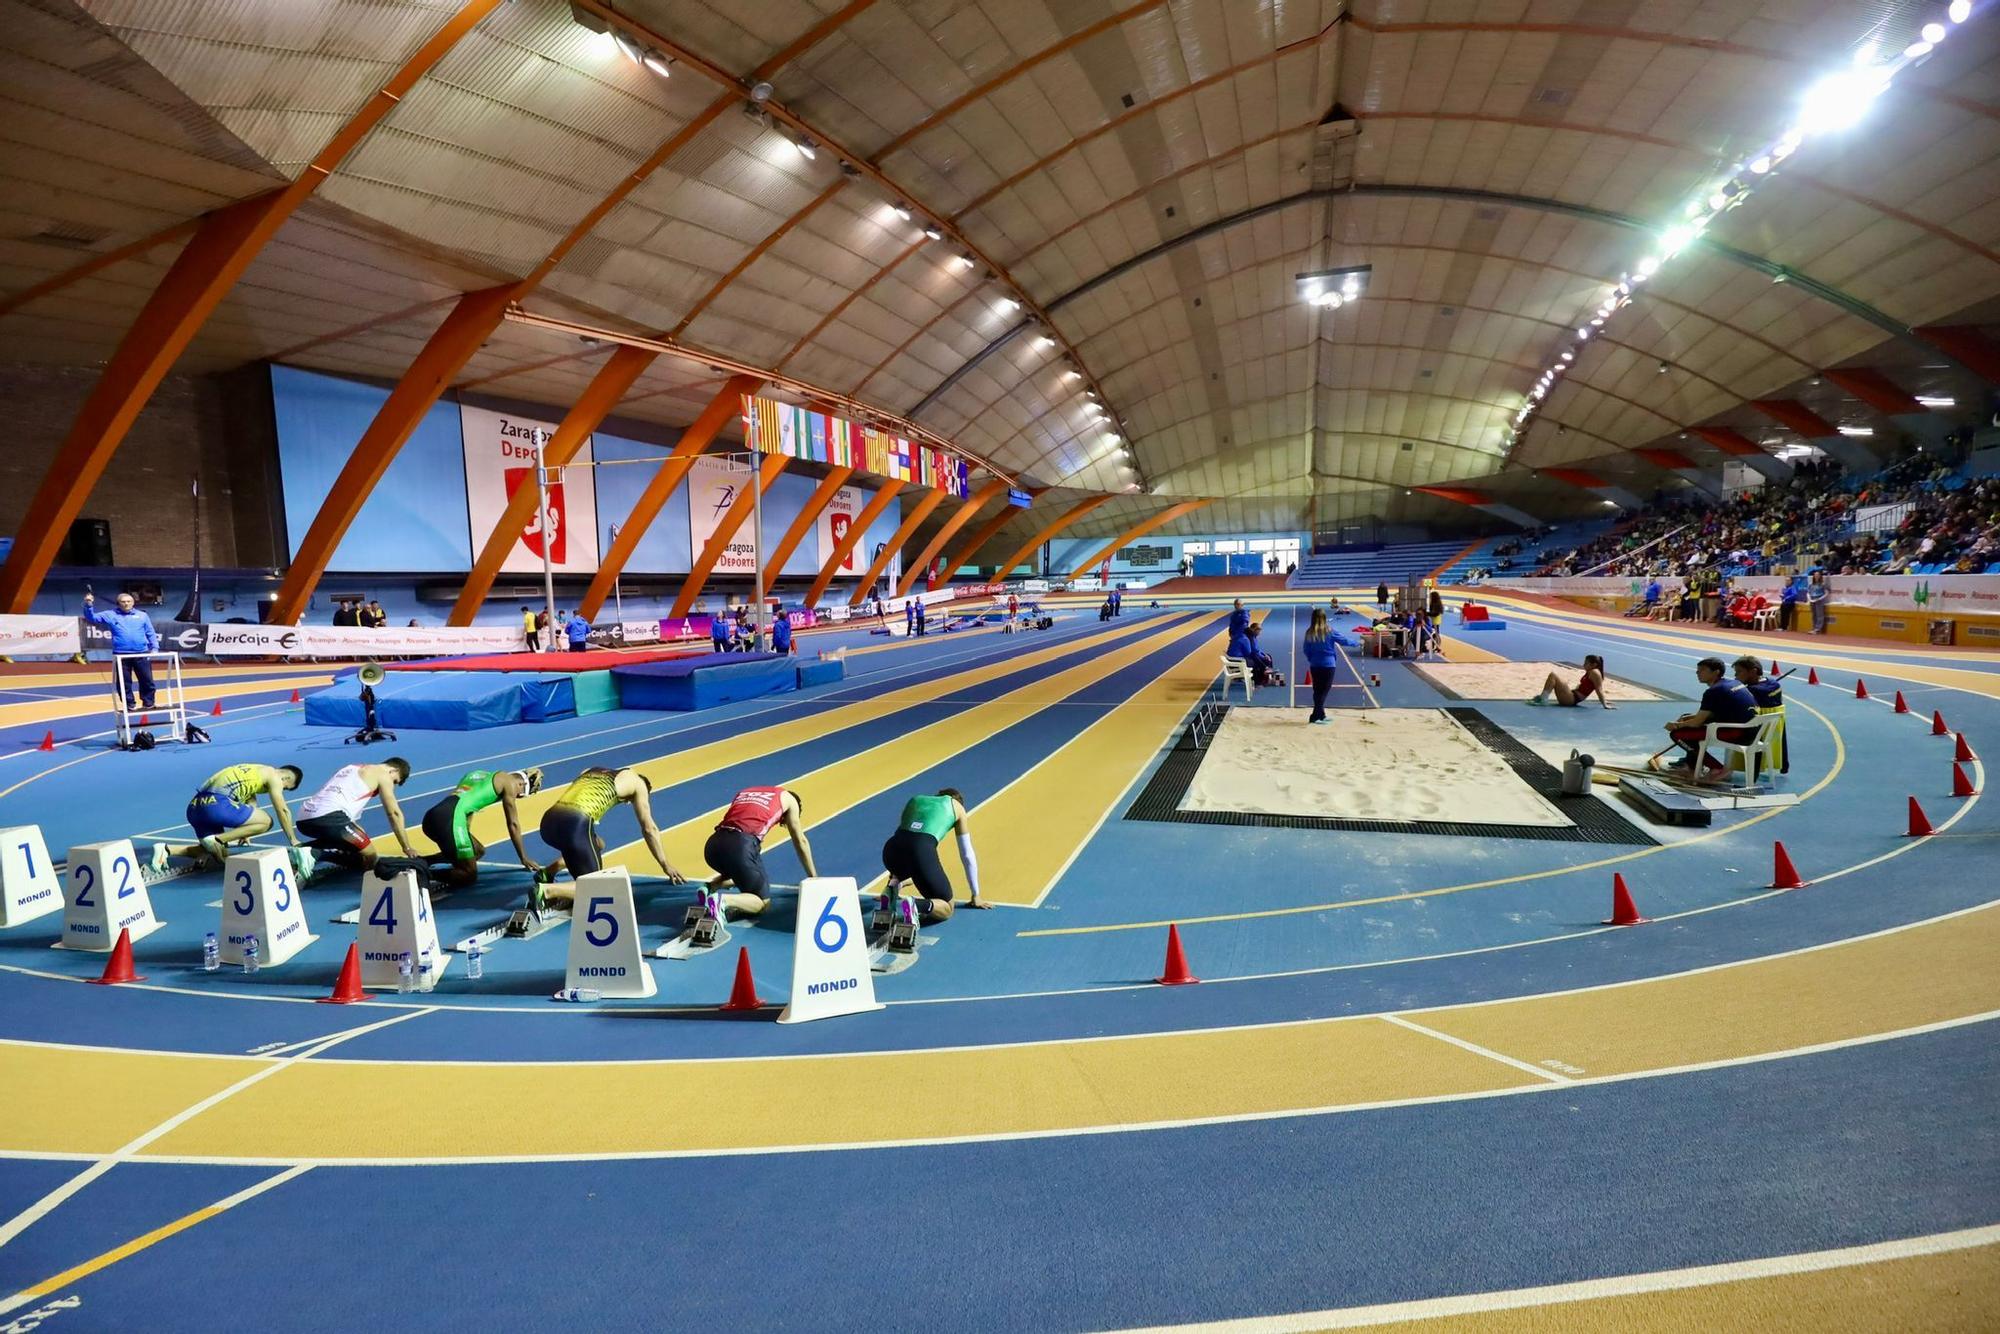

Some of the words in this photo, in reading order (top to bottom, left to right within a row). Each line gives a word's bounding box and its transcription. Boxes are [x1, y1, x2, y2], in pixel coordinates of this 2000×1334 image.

[724, 543, 754, 556] aragoza
[211, 632, 270, 647] iberCaja
[18, 842, 36, 880] 1
[75, 864, 95, 907] 2
[112, 856, 136, 899] 2
[273, 868, 291, 912] 3
[17, 888, 52, 906] MONDO
[233, 870, 255, 916] 3
[118, 910, 146, 928] MONDO
[368, 886, 398, 934] 4
[585, 897, 619, 947] 5
[813, 896, 848, 953] 6
[70, 923, 100, 934] MONDO
[276, 921, 300, 942] MONDO
[579, 967, 626, 977] MONDO
[807, 978, 858, 995] MONDO
